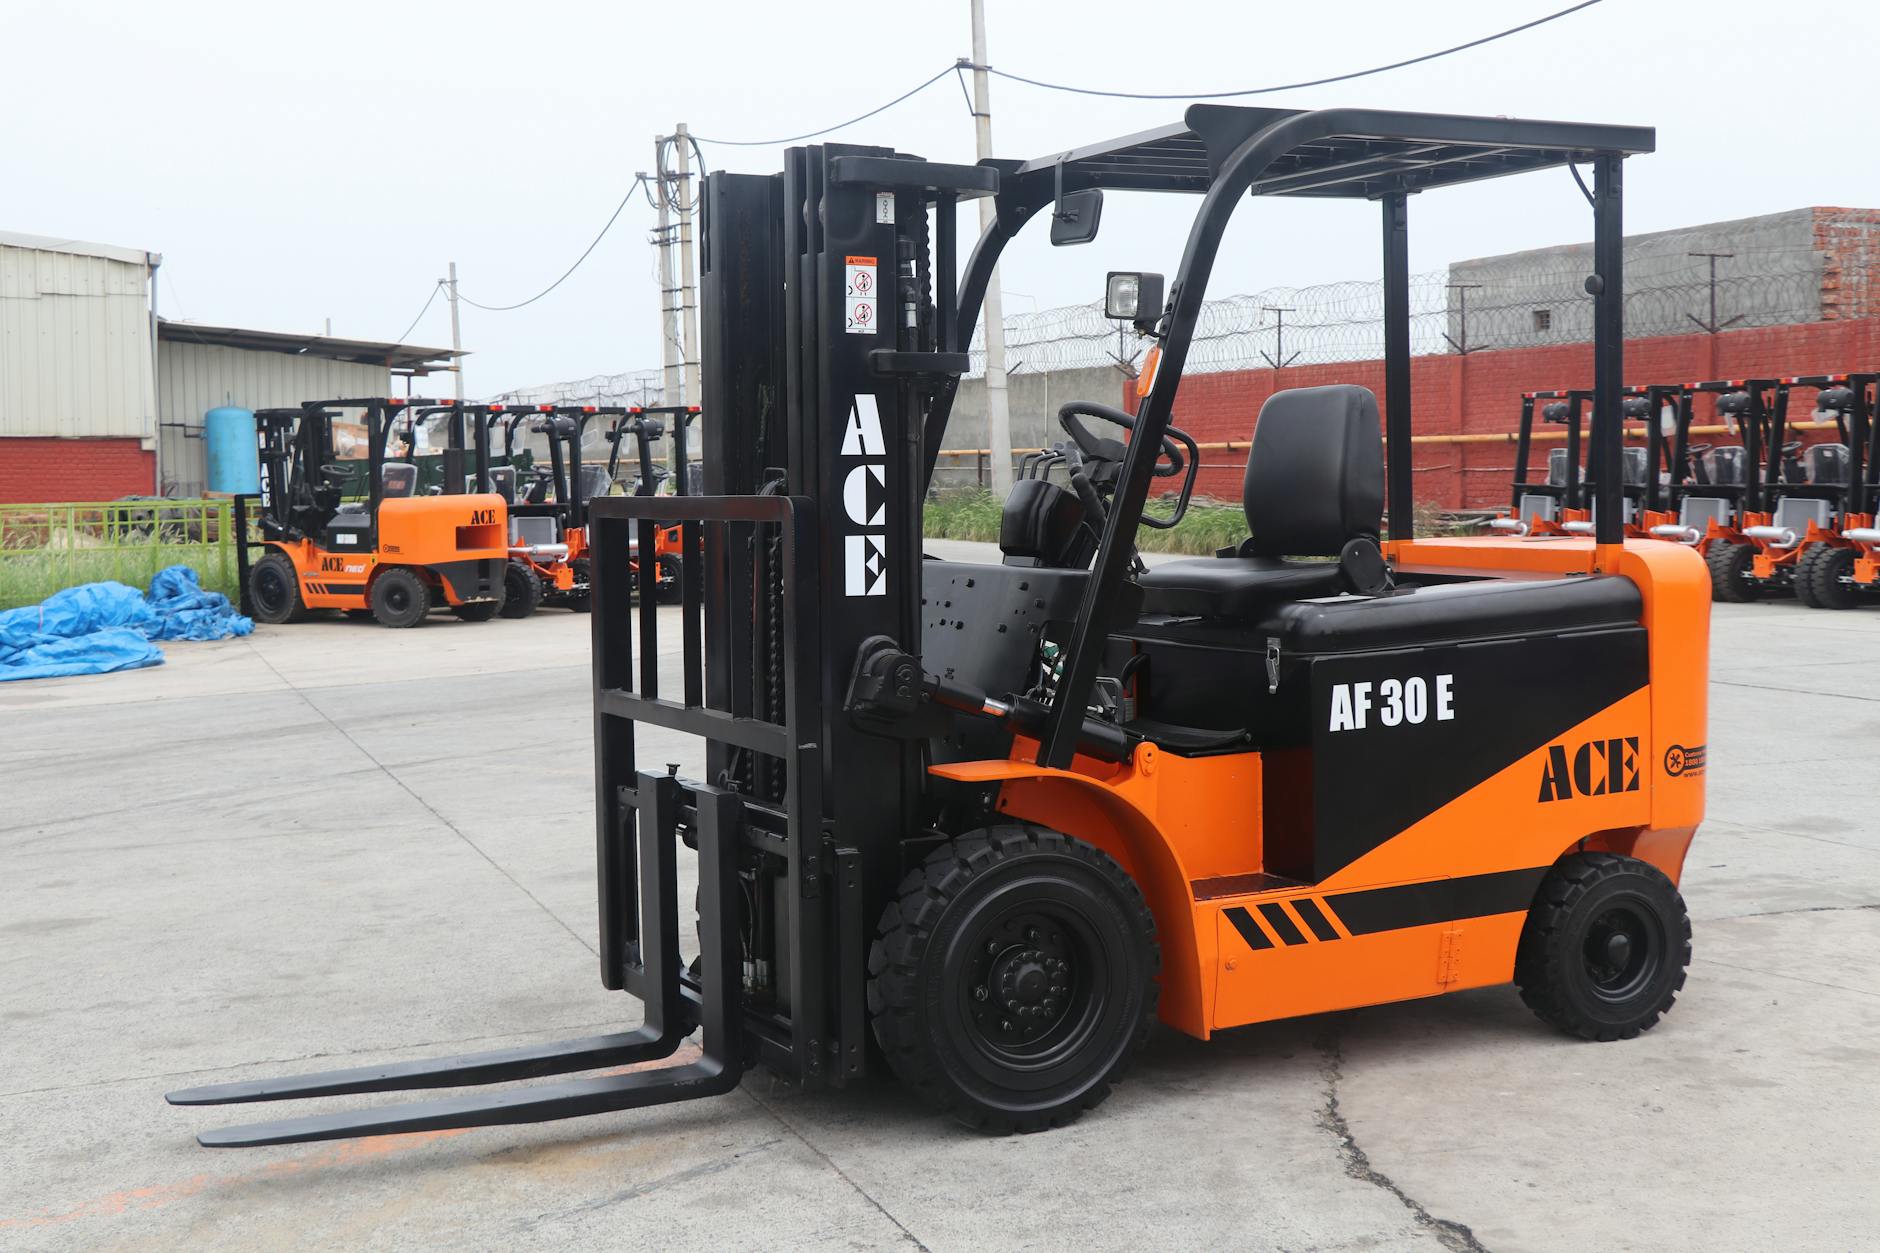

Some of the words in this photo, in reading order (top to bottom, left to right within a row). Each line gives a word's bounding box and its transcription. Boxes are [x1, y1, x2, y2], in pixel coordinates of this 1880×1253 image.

[261, 463, 270, 507] ACE
[841, 394, 886, 596] ACE
[471, 509, 496, 525] ACE
[321, 557, 344, 572] ACE
[1329, 682, 1372, 732] AF
[1380, 676, 1428, 727] 30
[1436, 674, 1455, 721] E
[1538, 736, 1640, 803] ACE
